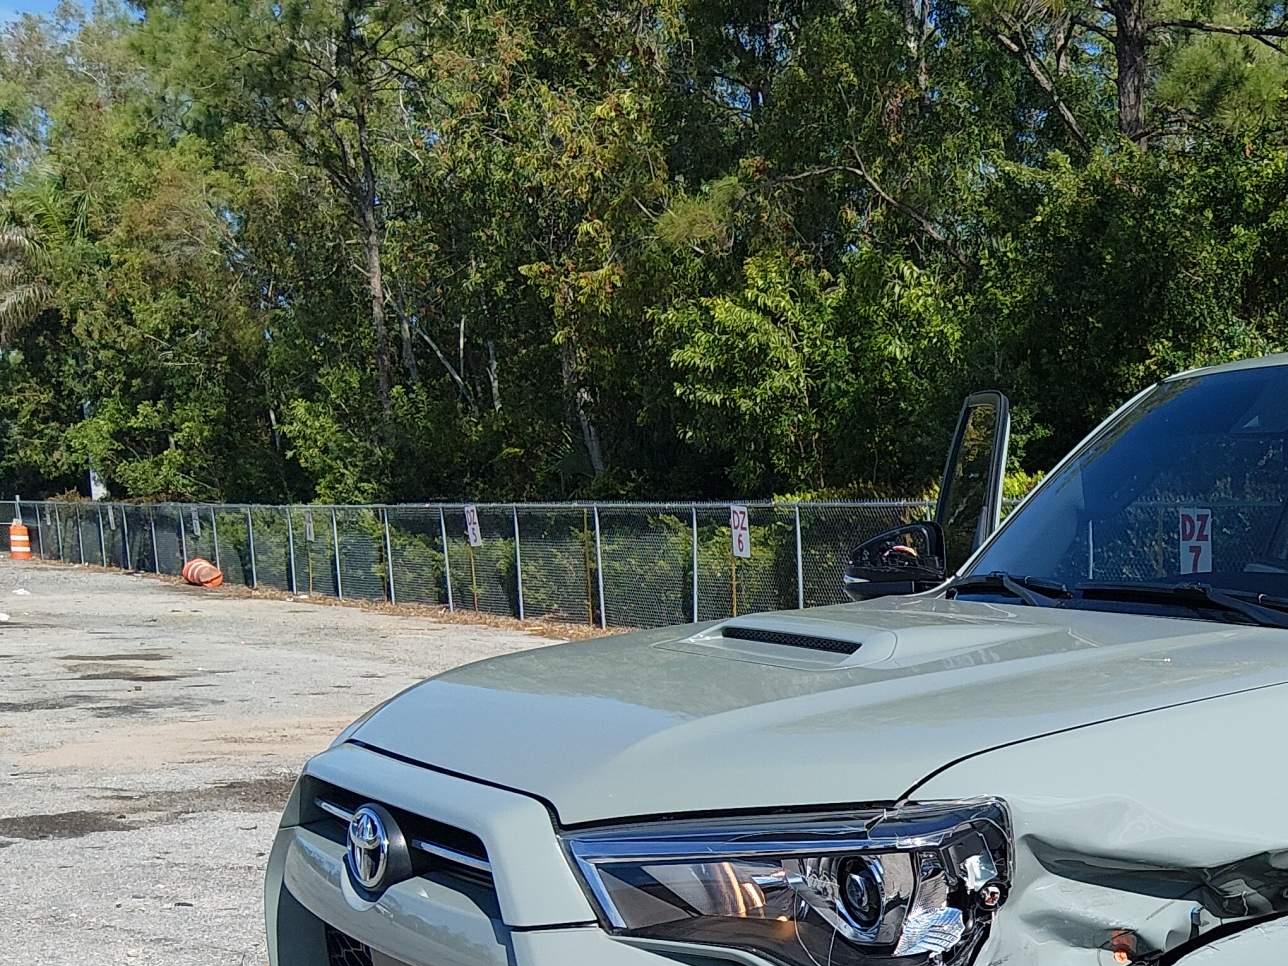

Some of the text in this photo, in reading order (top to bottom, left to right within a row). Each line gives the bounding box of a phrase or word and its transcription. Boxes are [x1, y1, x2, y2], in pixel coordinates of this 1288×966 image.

[733, 511, 747, 530] DZ
[1181, 514, 1210, 541] DZ
[738, 534, 744, 552] 6
[1189, 546, 1201, 574] 7
